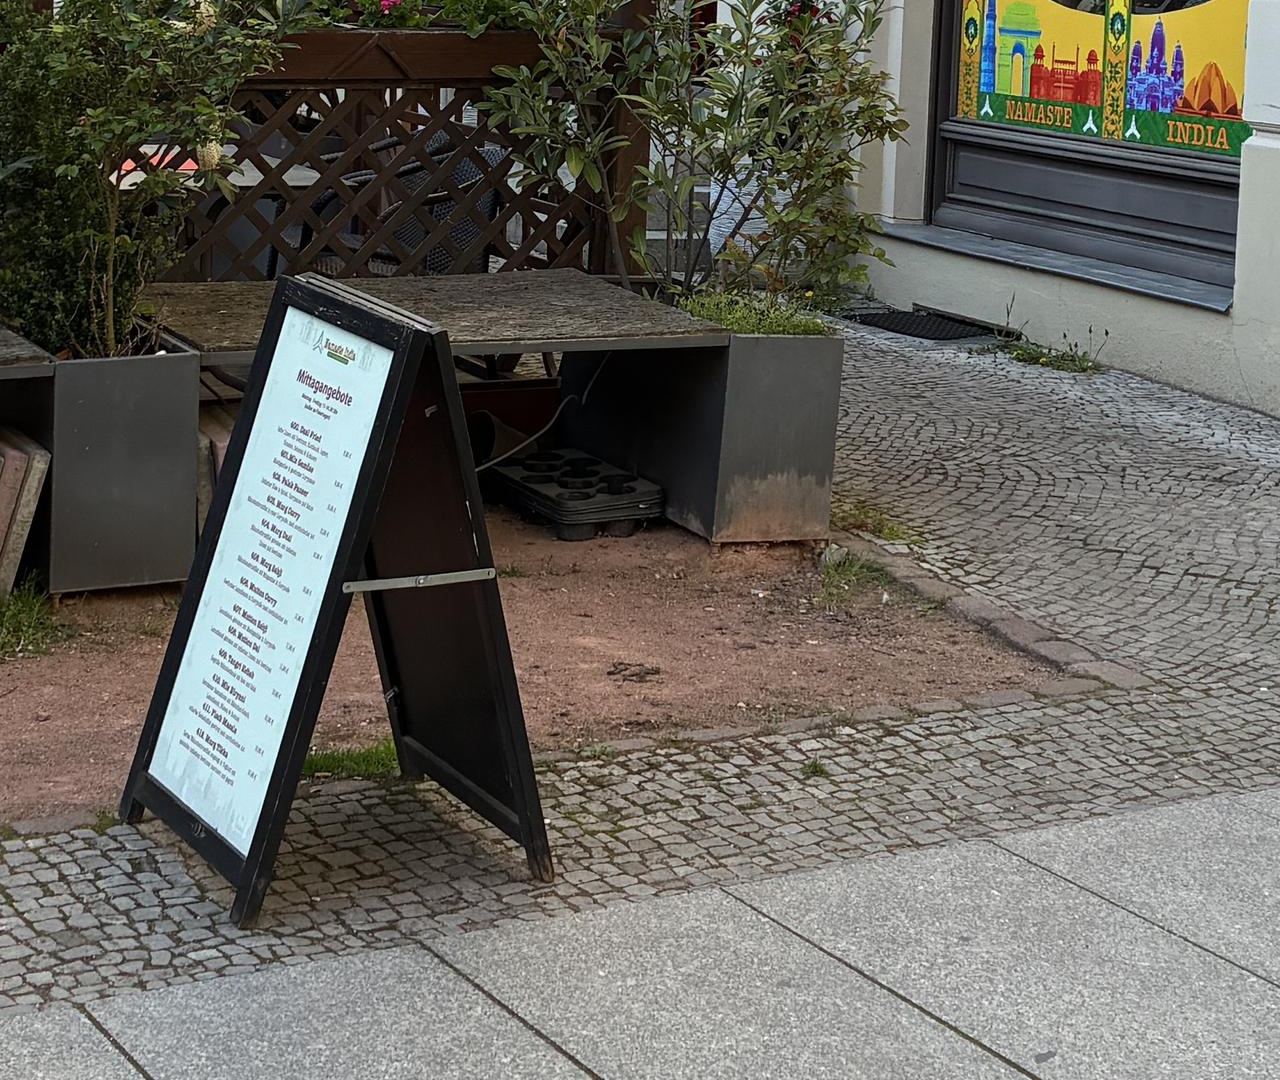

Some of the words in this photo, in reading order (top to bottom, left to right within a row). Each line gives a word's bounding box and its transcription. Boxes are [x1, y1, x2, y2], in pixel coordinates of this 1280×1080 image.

[1005, 100, 1073, 129] NAMASTE
[1166, 120, 1231, 150] INDIA
[296, 368, 353, 407] Mittagangebote
